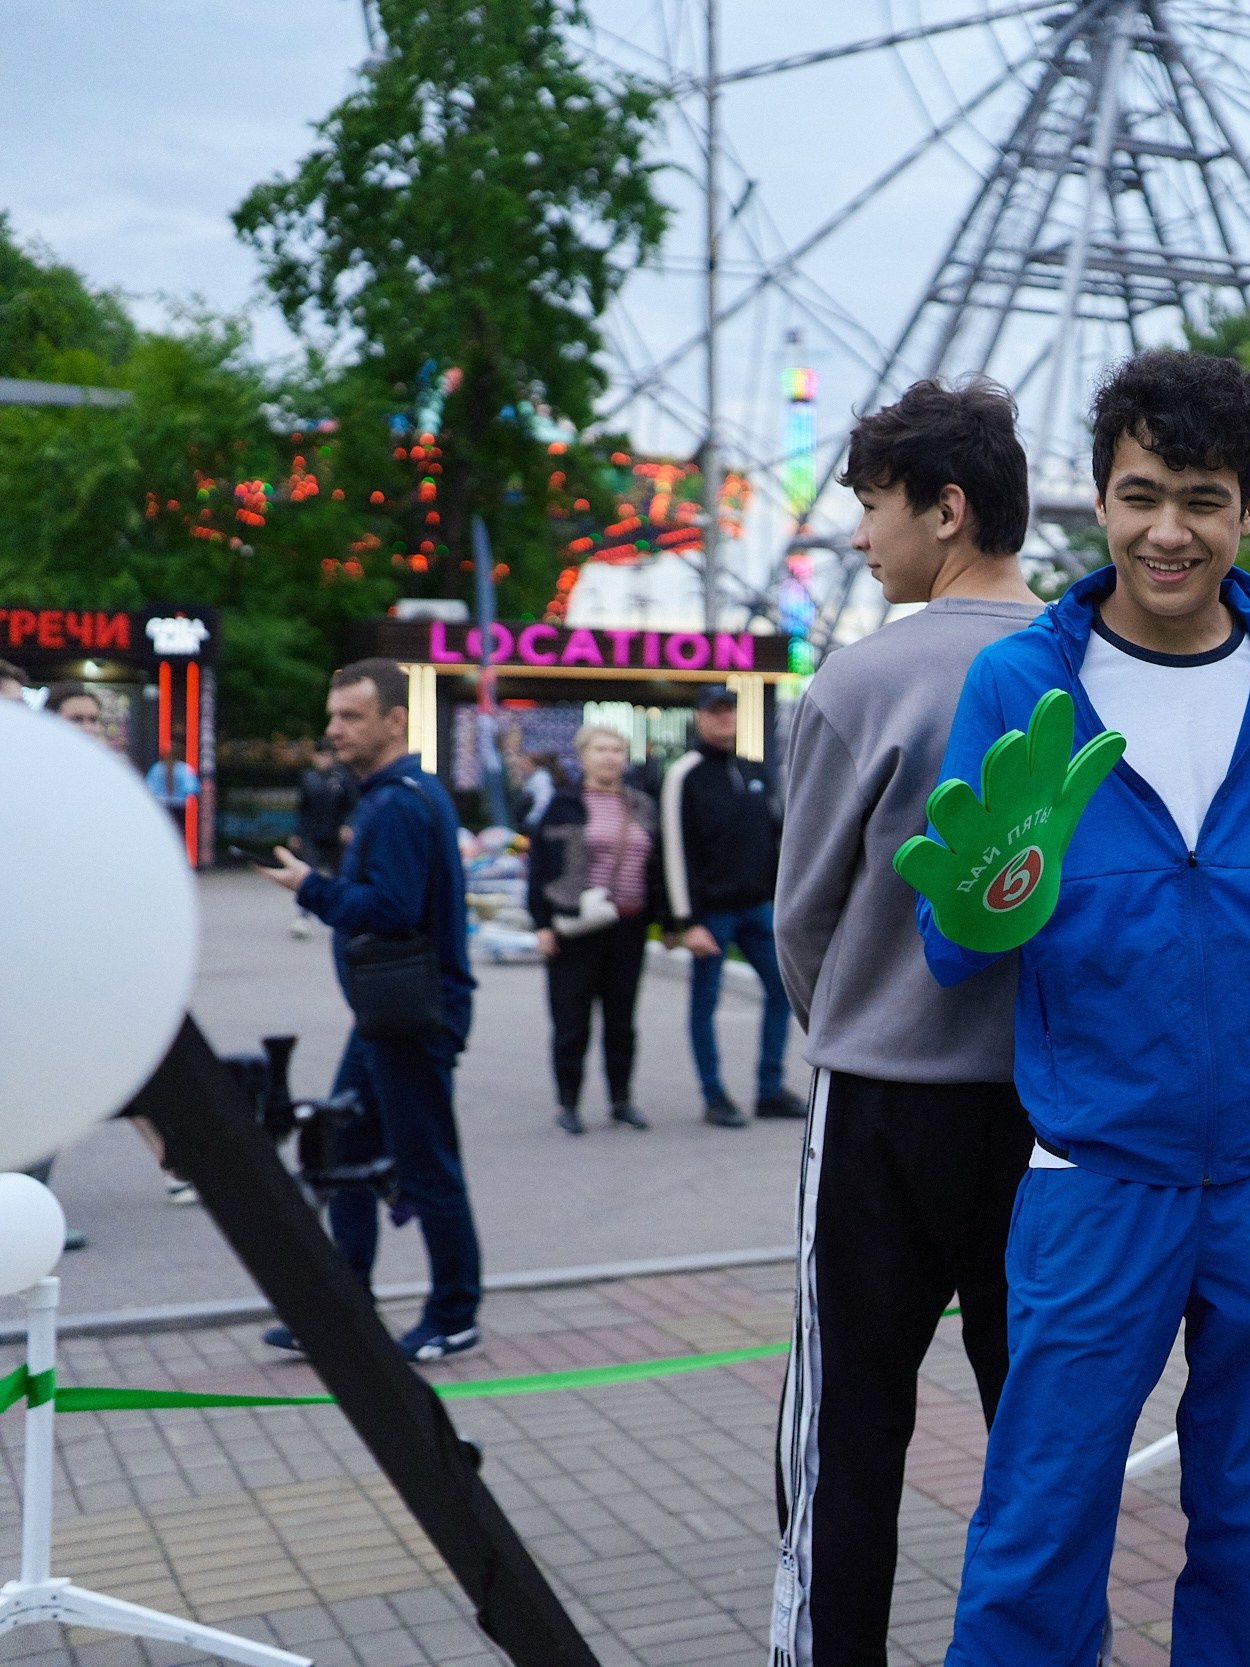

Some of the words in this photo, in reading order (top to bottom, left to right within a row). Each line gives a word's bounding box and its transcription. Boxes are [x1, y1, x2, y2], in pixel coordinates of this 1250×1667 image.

[429, 620, 755, 671] LOCATION
[956, 846, 1001, 893] ДАЙ
[1007, 805, 1053, 846] ПЯТЬ!
